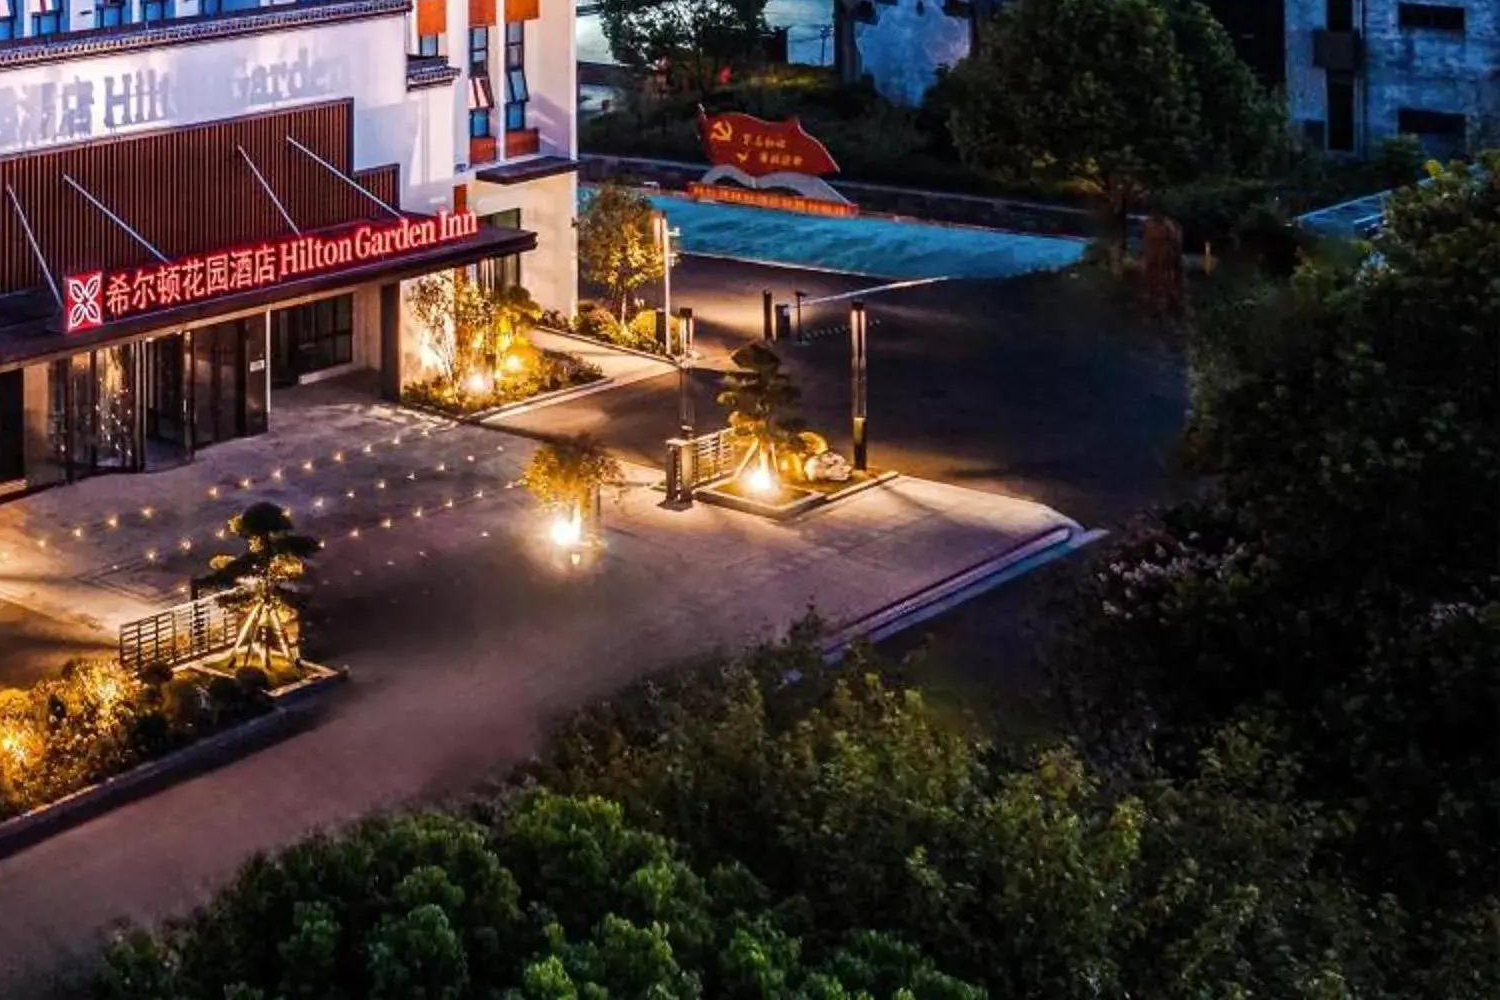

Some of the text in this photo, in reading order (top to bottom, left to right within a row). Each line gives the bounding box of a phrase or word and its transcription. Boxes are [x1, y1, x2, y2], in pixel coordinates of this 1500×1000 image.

[280, 207, 479, 276] Hilton Garden Inn
[105, 247, 277, 315] 希尔顿花园酒店
